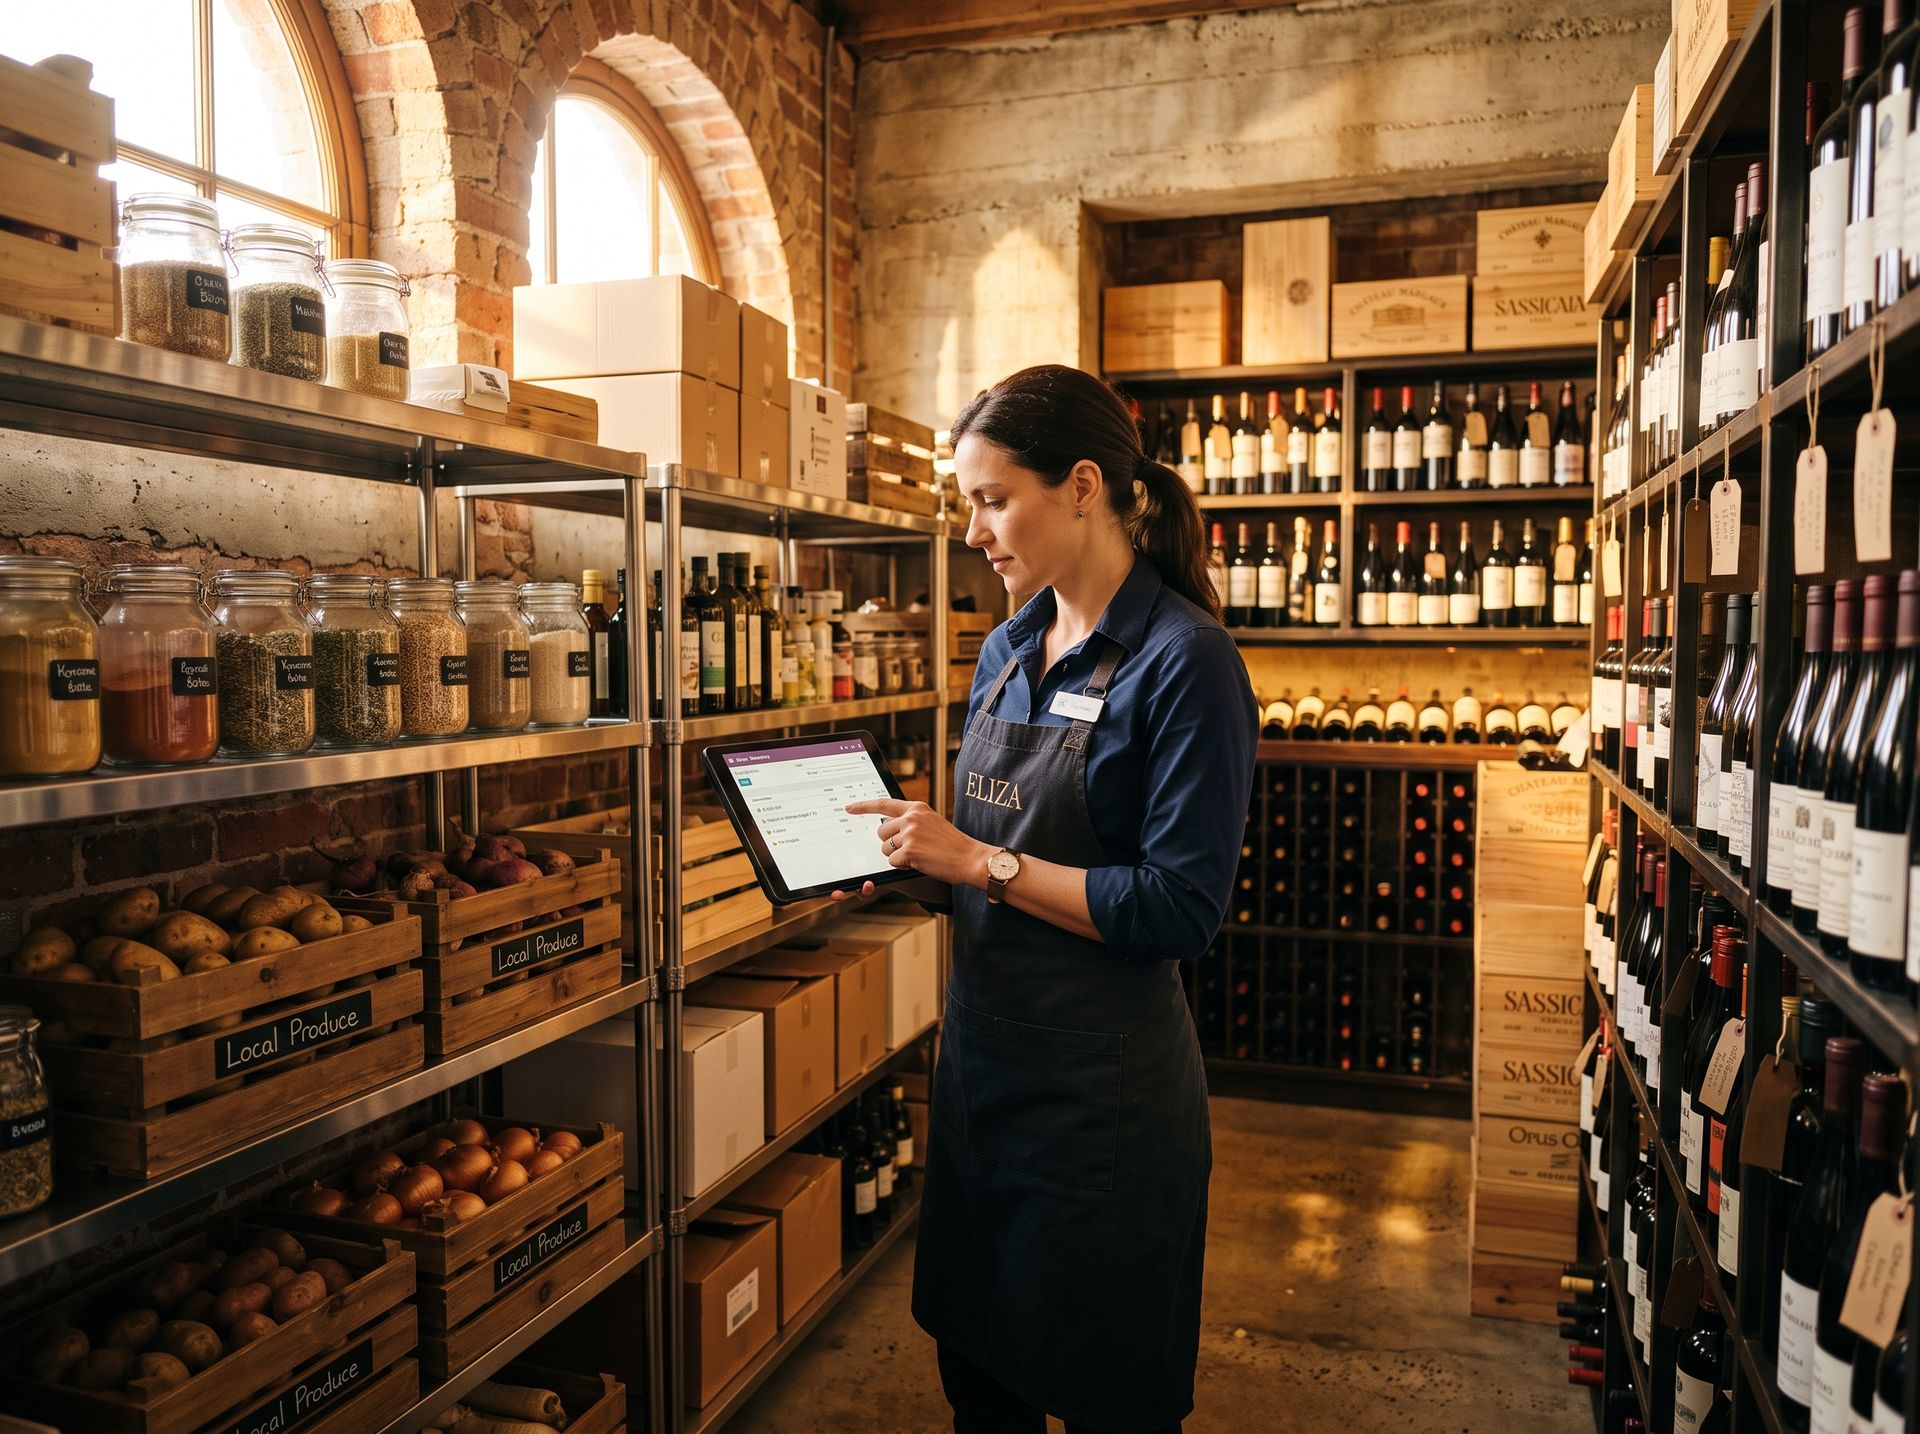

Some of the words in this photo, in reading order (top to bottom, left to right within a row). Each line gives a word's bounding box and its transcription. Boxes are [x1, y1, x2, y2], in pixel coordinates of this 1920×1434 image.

[965, 771, 1023, 811] ELIZA
[497, 948, 530, 971] Local
[536, 931, 579, 956] Produce
[1504, 990, 1584, 1016] SASSIC
[227, 1026, 279, 1070] Local
[290, 1008, 360, 1047] Produce
[500, 1249, 532, 1284] Local
[538, 1218, 583, 1257] Produce
[295, 1362, 359, 1415] Produce
